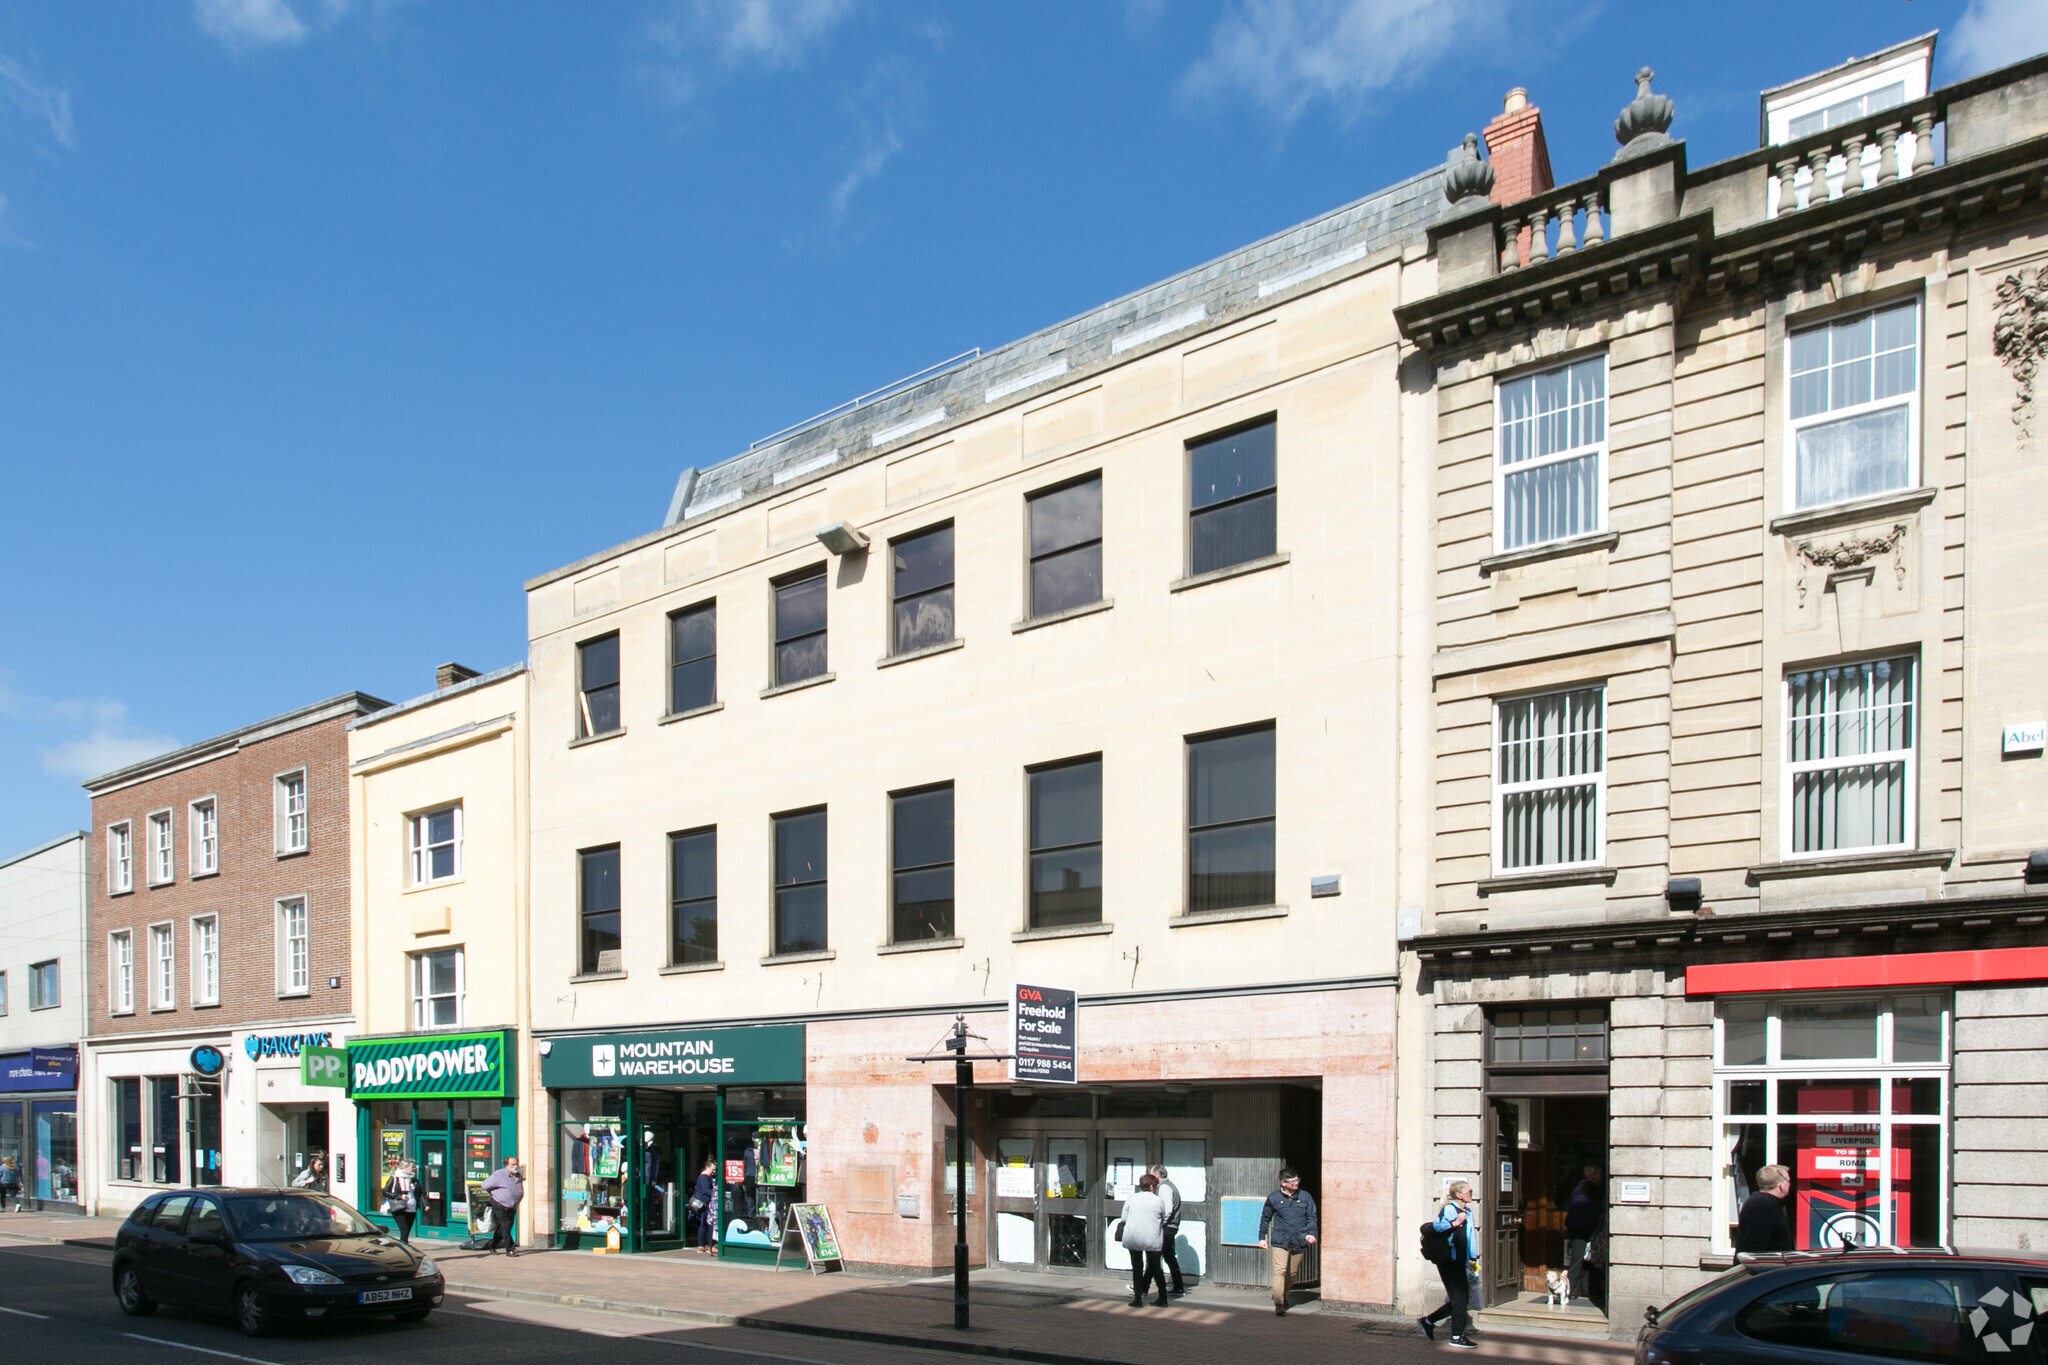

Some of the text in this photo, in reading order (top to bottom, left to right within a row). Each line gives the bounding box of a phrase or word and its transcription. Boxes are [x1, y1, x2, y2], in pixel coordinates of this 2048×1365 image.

[2008, 729, 2044, 744] Abel
[1019, 988, 1043, 1002] GVA
[1018, 1002, 1066, 1019] Freehold
[1018, 1018, 1062, 1034] For Sale
[261, 1032, 332, 1055] BARCLAYS
[620, 1040, 714, 1058] MOUNTAIN
[619, 1058, 735, 1076] WAREHOUSE
[1018, 1057, 1072, 1070] 0117 988 5454
[1830, 1137, 1876, 1145] LIVERPOOL
[1839, 1159, 1867, 1167] ROMA
[1844, 1176, 1861, 1184] 2-0
[364, 1289, 411, 1302] AB52 NHZ
